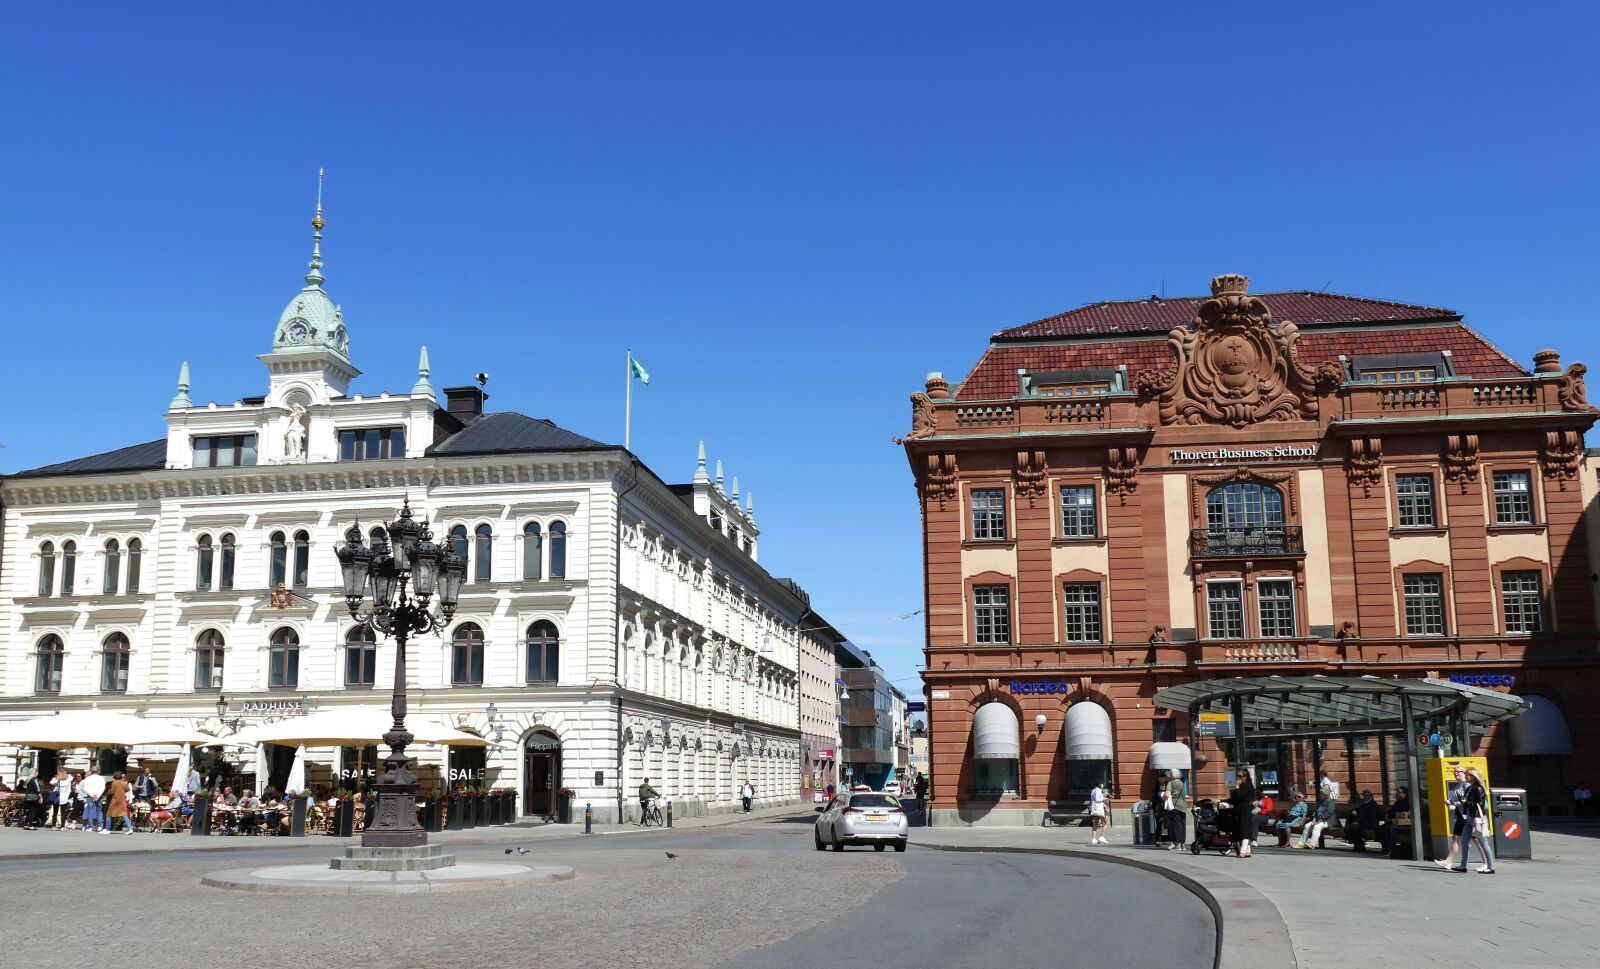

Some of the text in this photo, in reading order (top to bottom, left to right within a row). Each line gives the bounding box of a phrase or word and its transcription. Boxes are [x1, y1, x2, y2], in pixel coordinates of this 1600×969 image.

[1170, 445, 1316, 460] Thoren Business School
[1450, 672, 1513, 685] Nordea
[1010, 681, 1068, 693] Nordea
[449, 768, 484, 780] SALE
